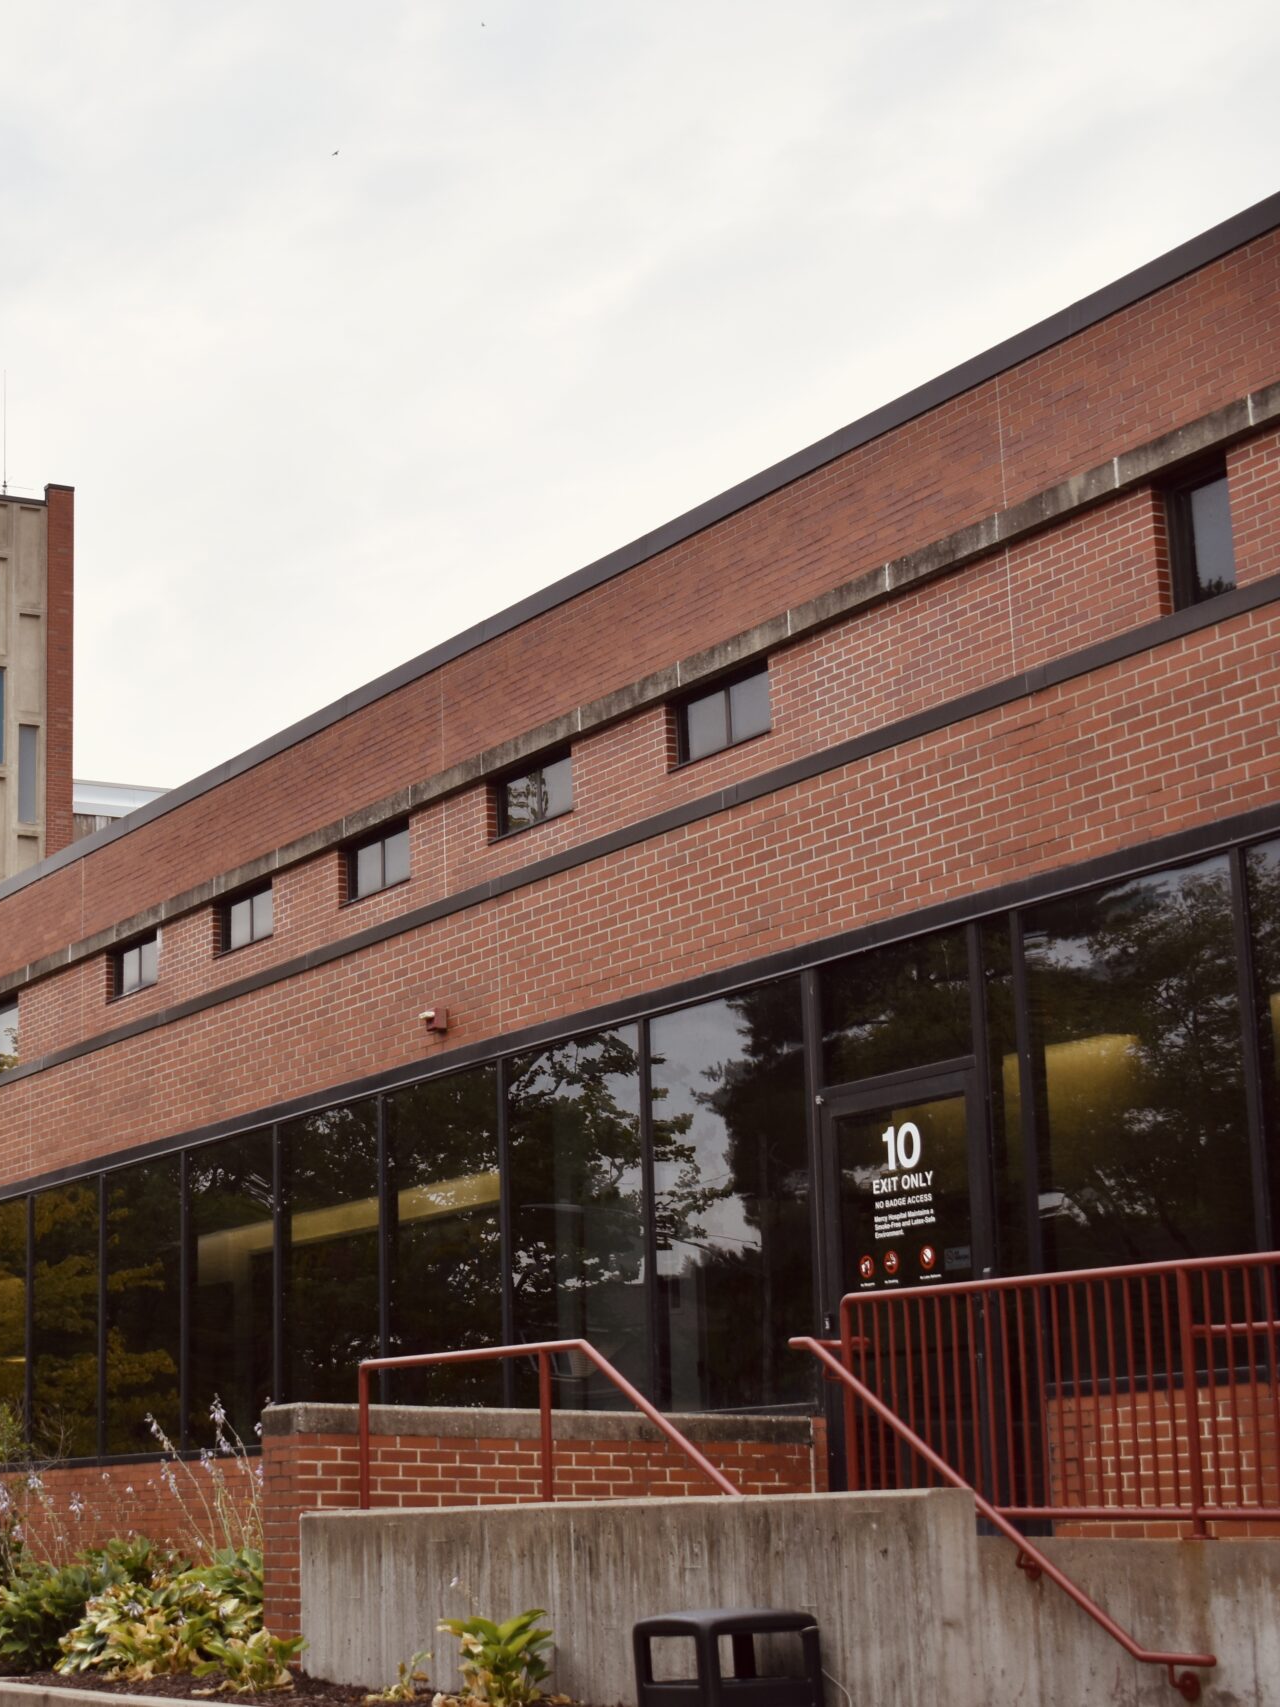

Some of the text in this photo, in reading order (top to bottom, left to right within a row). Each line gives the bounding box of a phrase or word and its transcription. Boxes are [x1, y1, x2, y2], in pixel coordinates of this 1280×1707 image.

[882, 1121, 921, 1171] 10
[872, 1170, 934, 1195] EXIT ONLY
[875, 1193, 933, 1209] NO BADGE ACCESS
[888, 1211, 907, 1220] Hospital
[902, 1219, 911, 1227] and
